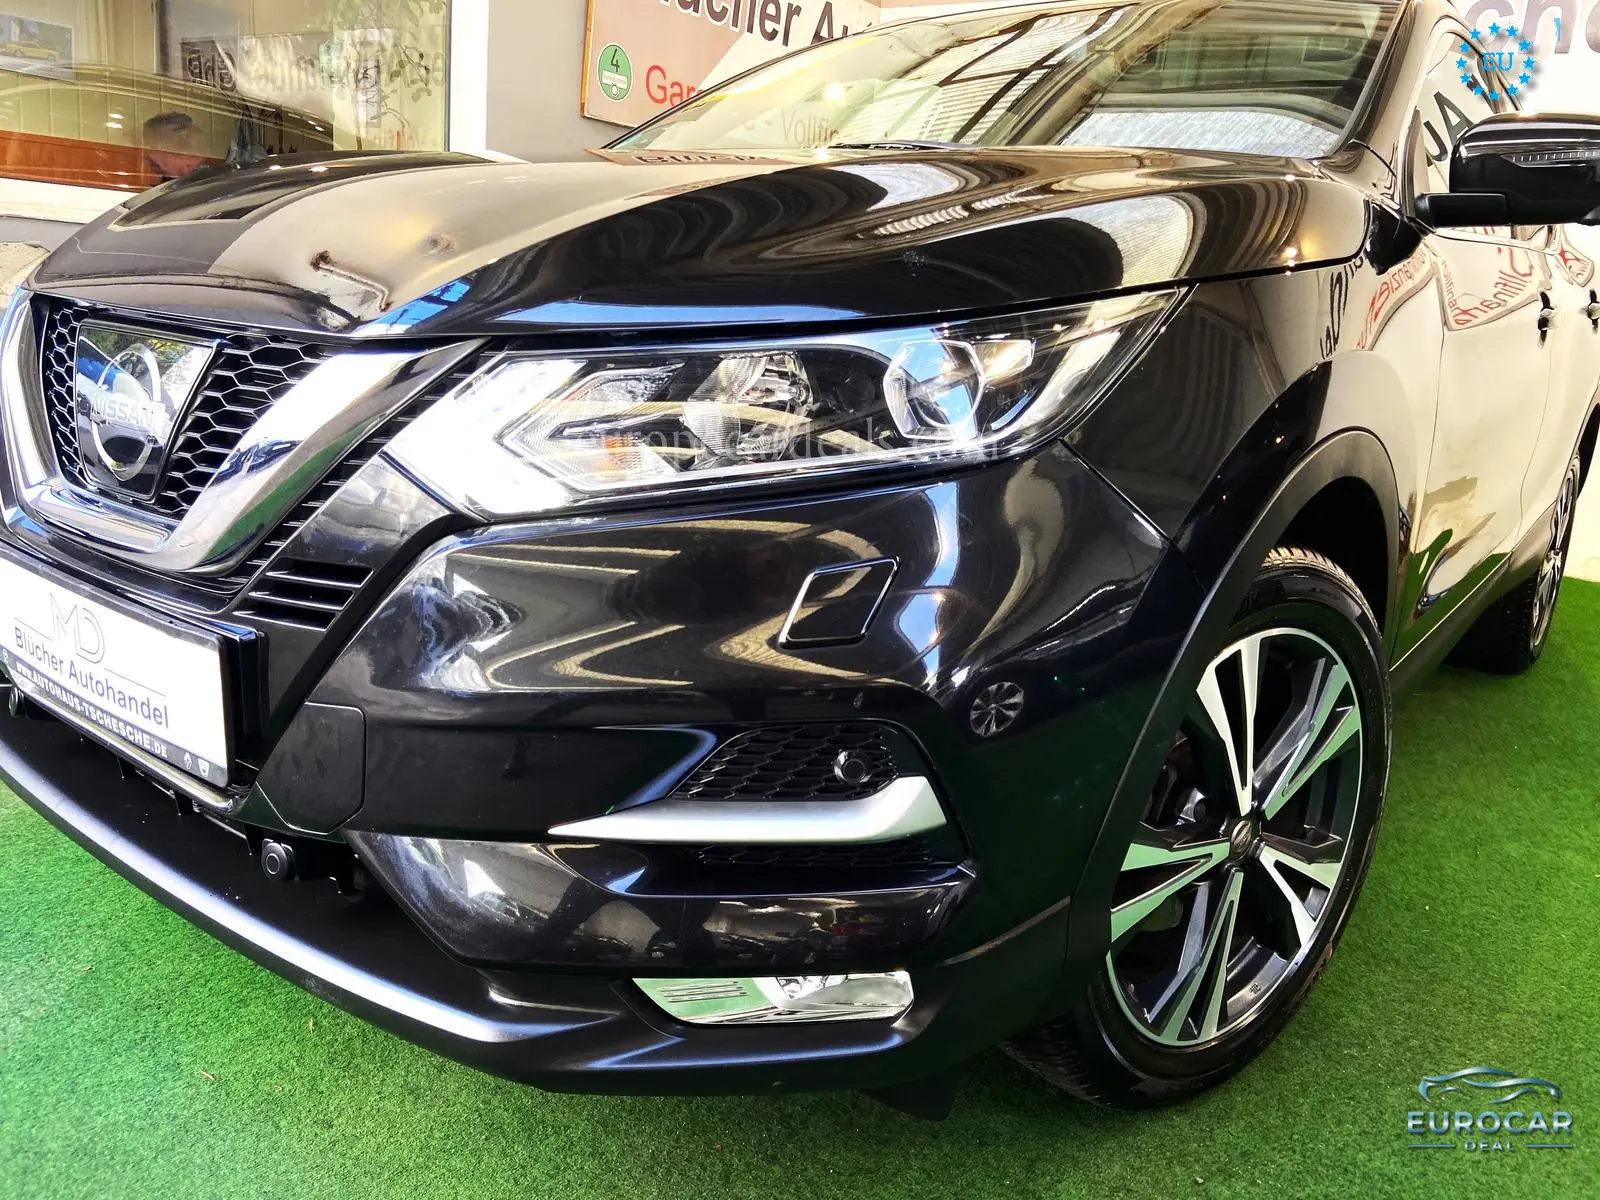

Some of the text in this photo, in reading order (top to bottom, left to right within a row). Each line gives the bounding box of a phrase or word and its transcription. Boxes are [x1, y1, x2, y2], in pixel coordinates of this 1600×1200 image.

[610, 47, 621, 73] 4
[645, 64, 702, 107] Gar
[14, 626, 169, 730] Blücher Autohandel
